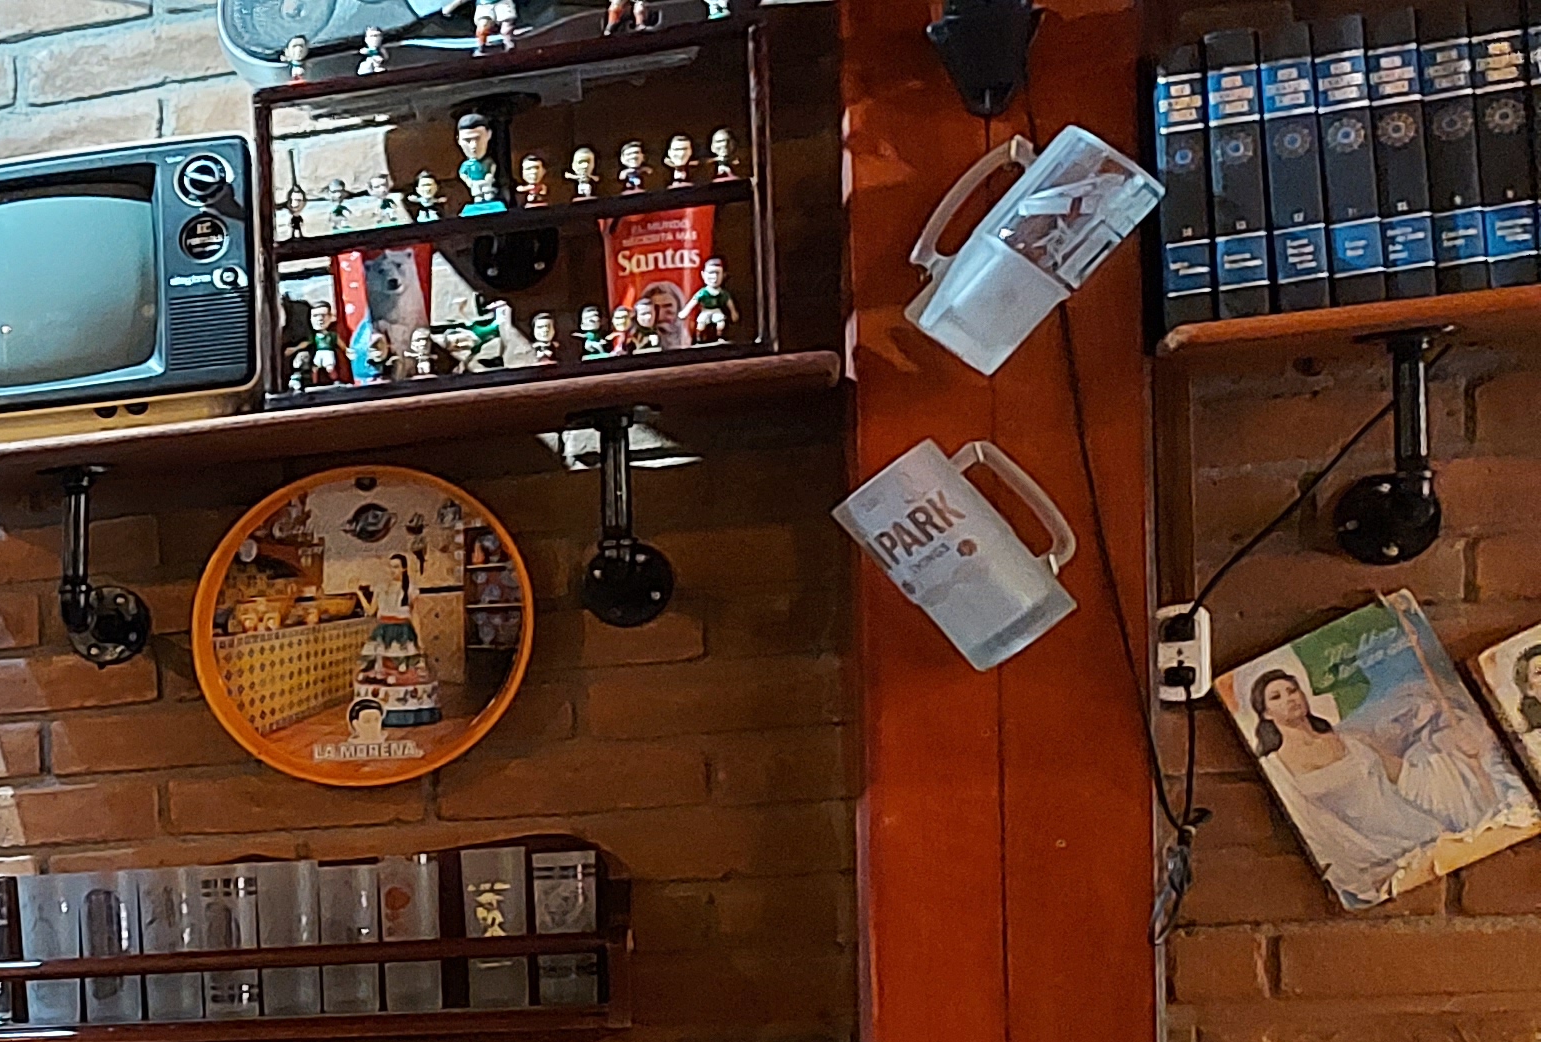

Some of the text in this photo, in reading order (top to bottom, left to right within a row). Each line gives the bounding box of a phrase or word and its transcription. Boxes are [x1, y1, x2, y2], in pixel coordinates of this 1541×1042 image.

[617, 247, 701, 276] Santas
[314, 740, 417, 759] LA MORENA
